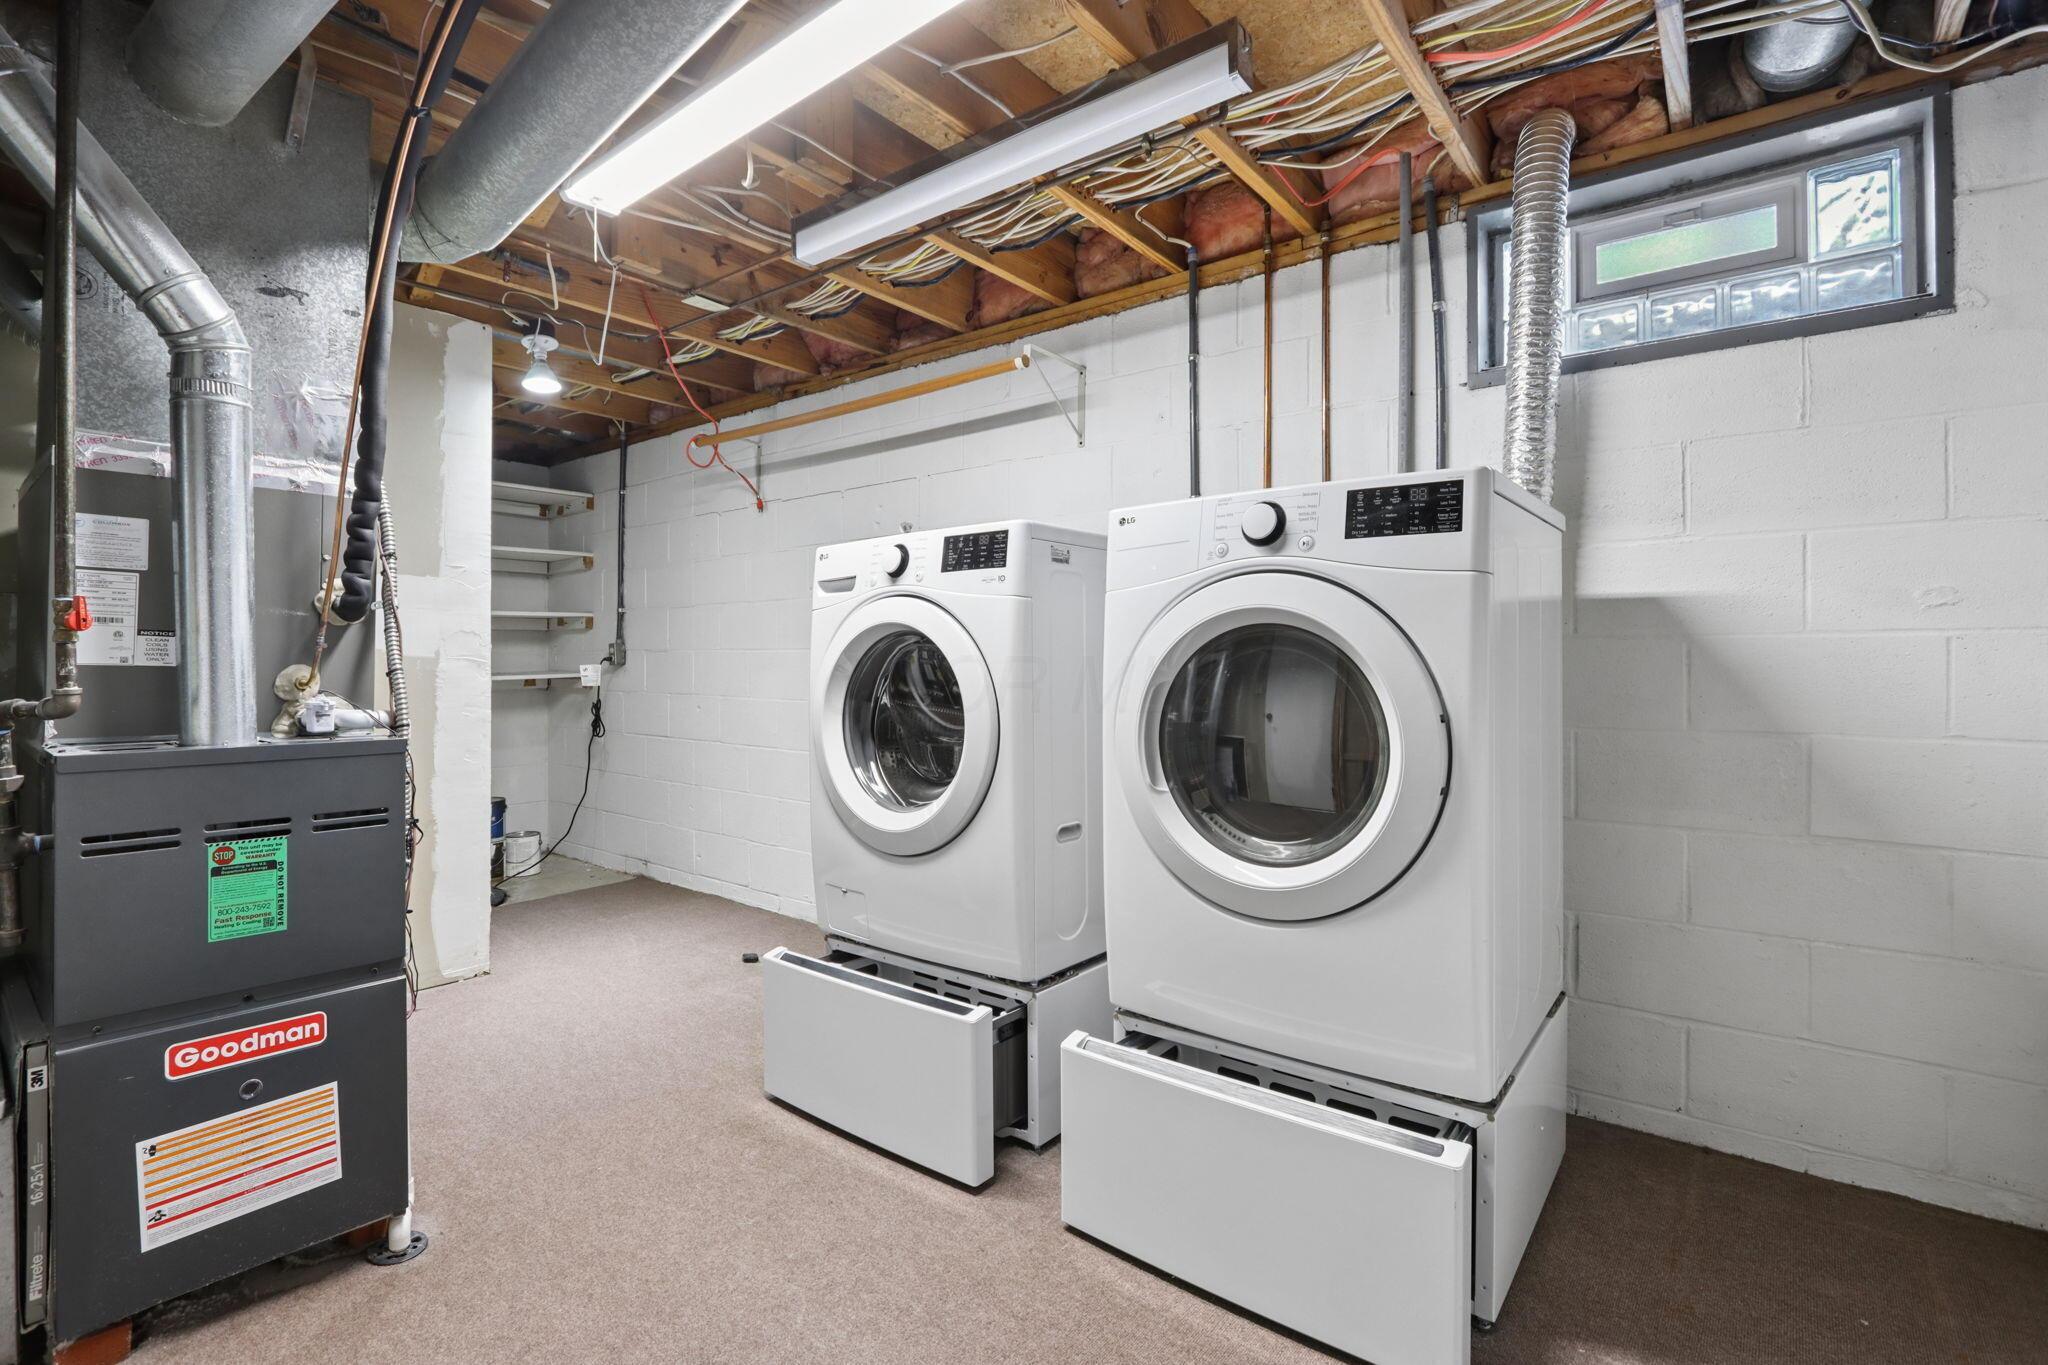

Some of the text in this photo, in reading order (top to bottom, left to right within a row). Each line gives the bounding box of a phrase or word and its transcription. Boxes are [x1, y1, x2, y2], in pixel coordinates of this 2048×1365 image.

[214, 850, 235, 861] STOP
[278, 861, 284, 872] DO
[214, 911, 272, 925] Fast Response
[174, 1022, 320, 1068] Goodman
[31, 1069, 43, 1088] 3M
[30, 1162, 44, 1206] 16x25x1
[29, 1254, 44, 1302] Filtrete
